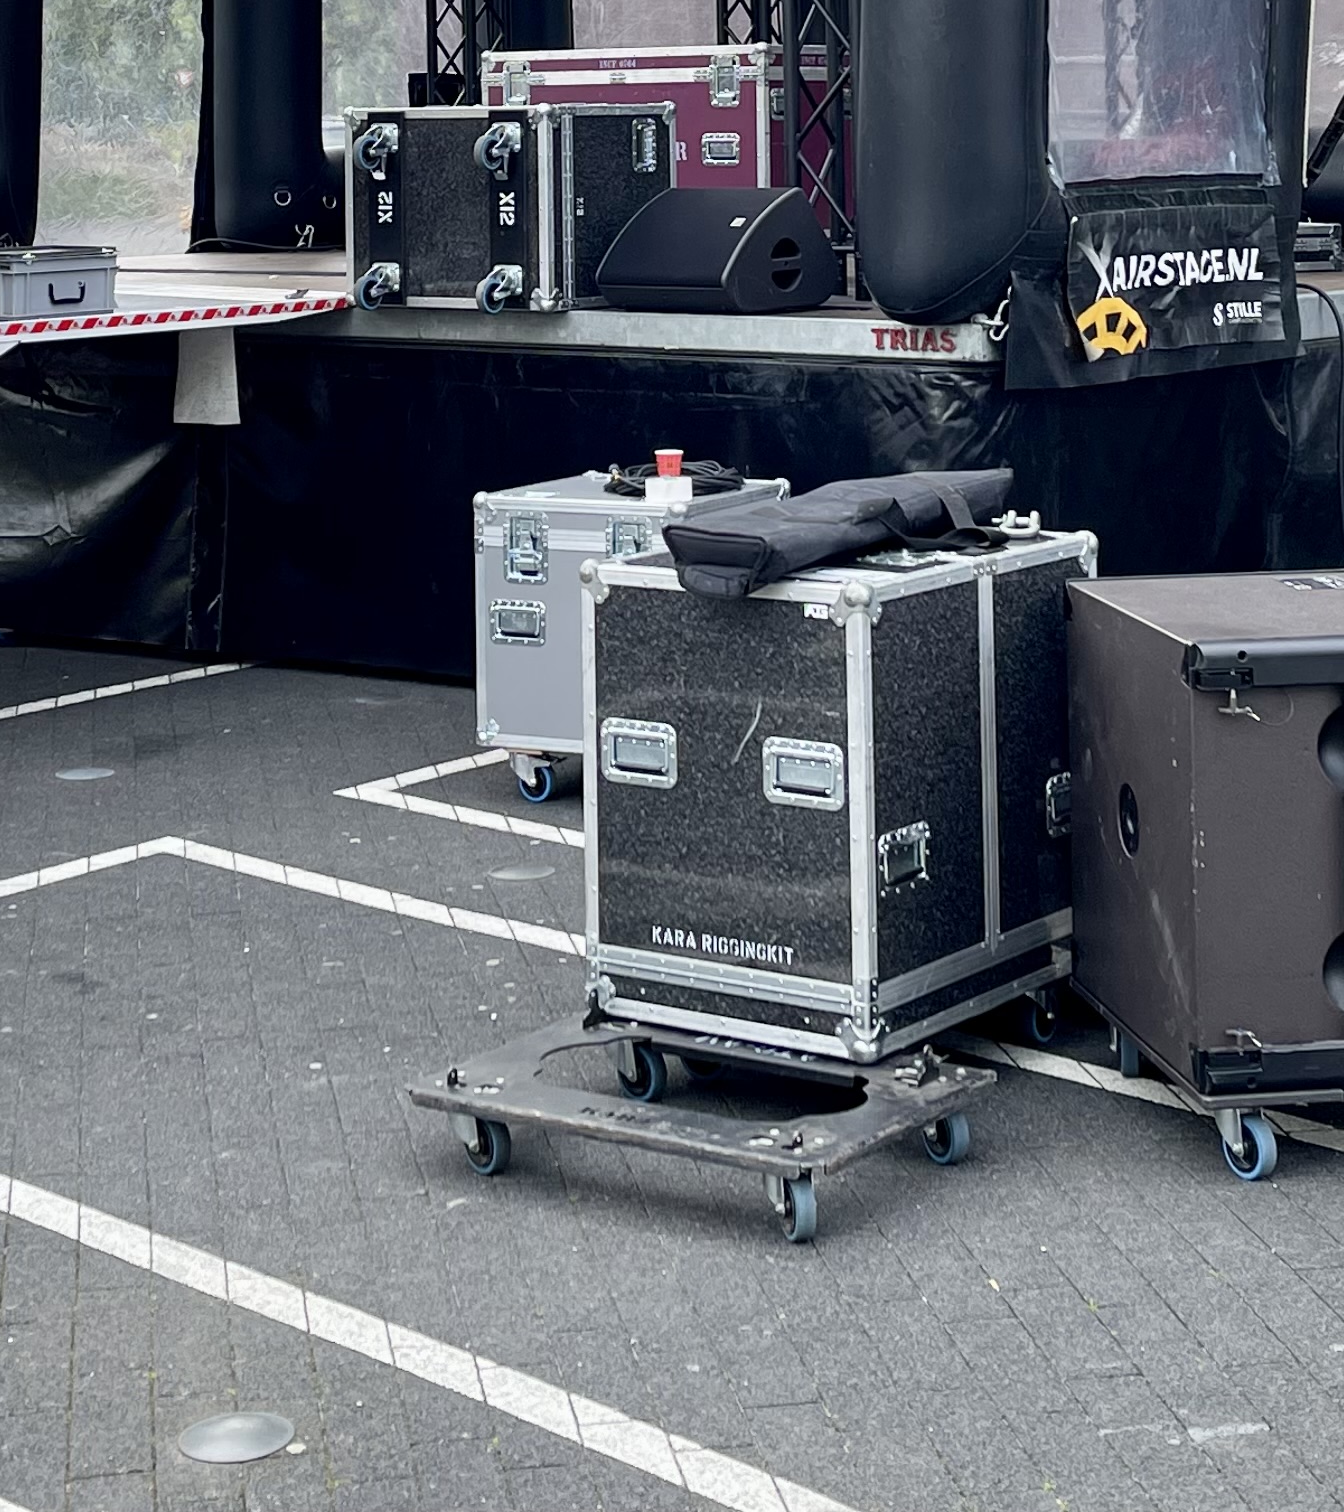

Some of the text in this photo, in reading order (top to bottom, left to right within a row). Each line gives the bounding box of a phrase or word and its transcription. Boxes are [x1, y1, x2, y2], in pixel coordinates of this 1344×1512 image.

[676, 141, 688, 161] R
[1226, 301, 1263, 319] STILLE
[871, 327, 957, 353] TRIAS
[652, 925, 794, 965] KARA RIGGINGKIT
